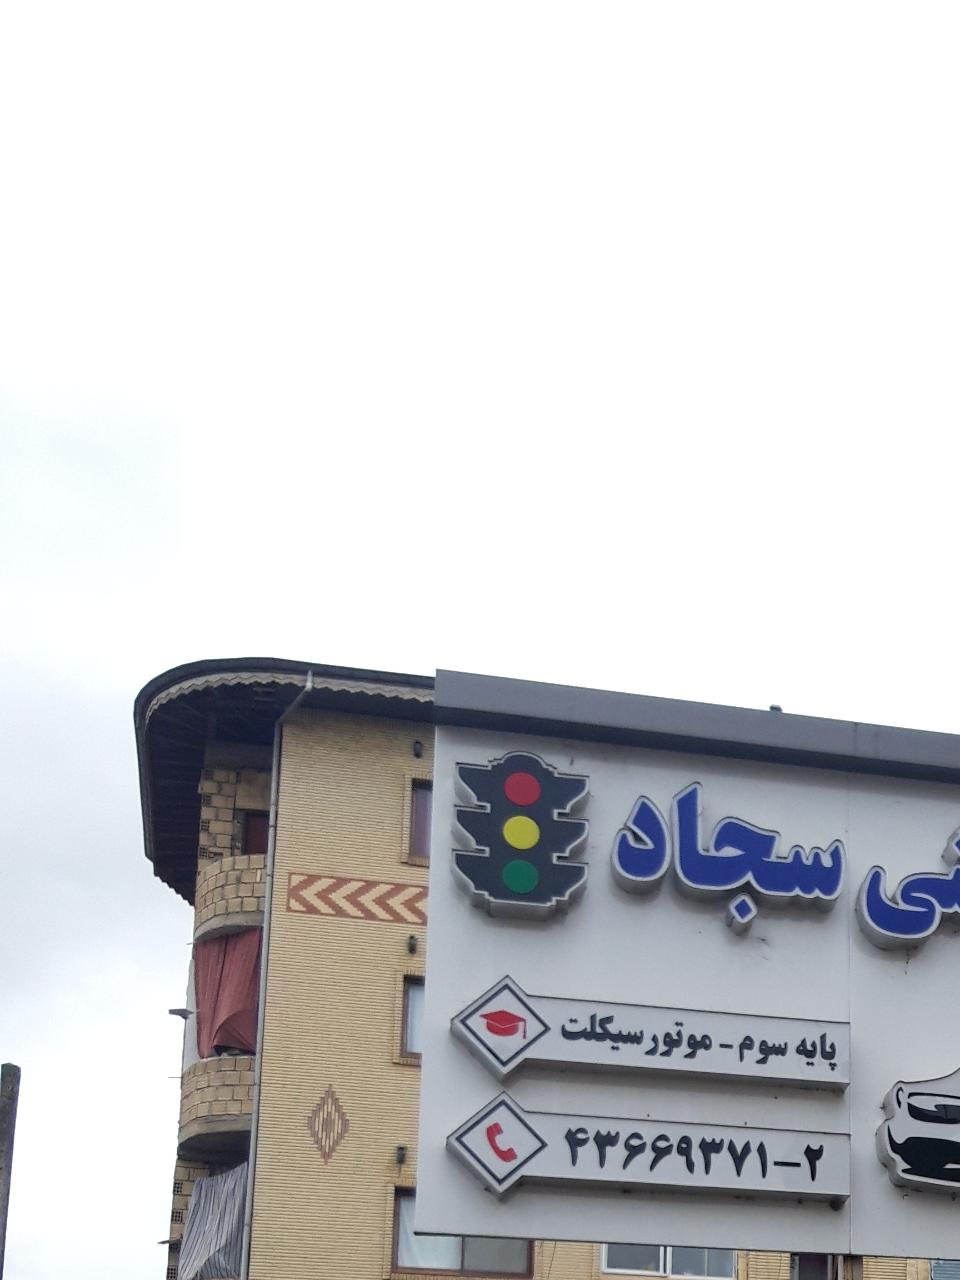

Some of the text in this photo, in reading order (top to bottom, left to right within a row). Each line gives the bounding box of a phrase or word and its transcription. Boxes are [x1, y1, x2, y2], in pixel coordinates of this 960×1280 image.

[612, 780, 844, 924] سجاد
[738, 1034, 788, 1065] سوم
[795, 1032, 837, 1071] پایه
